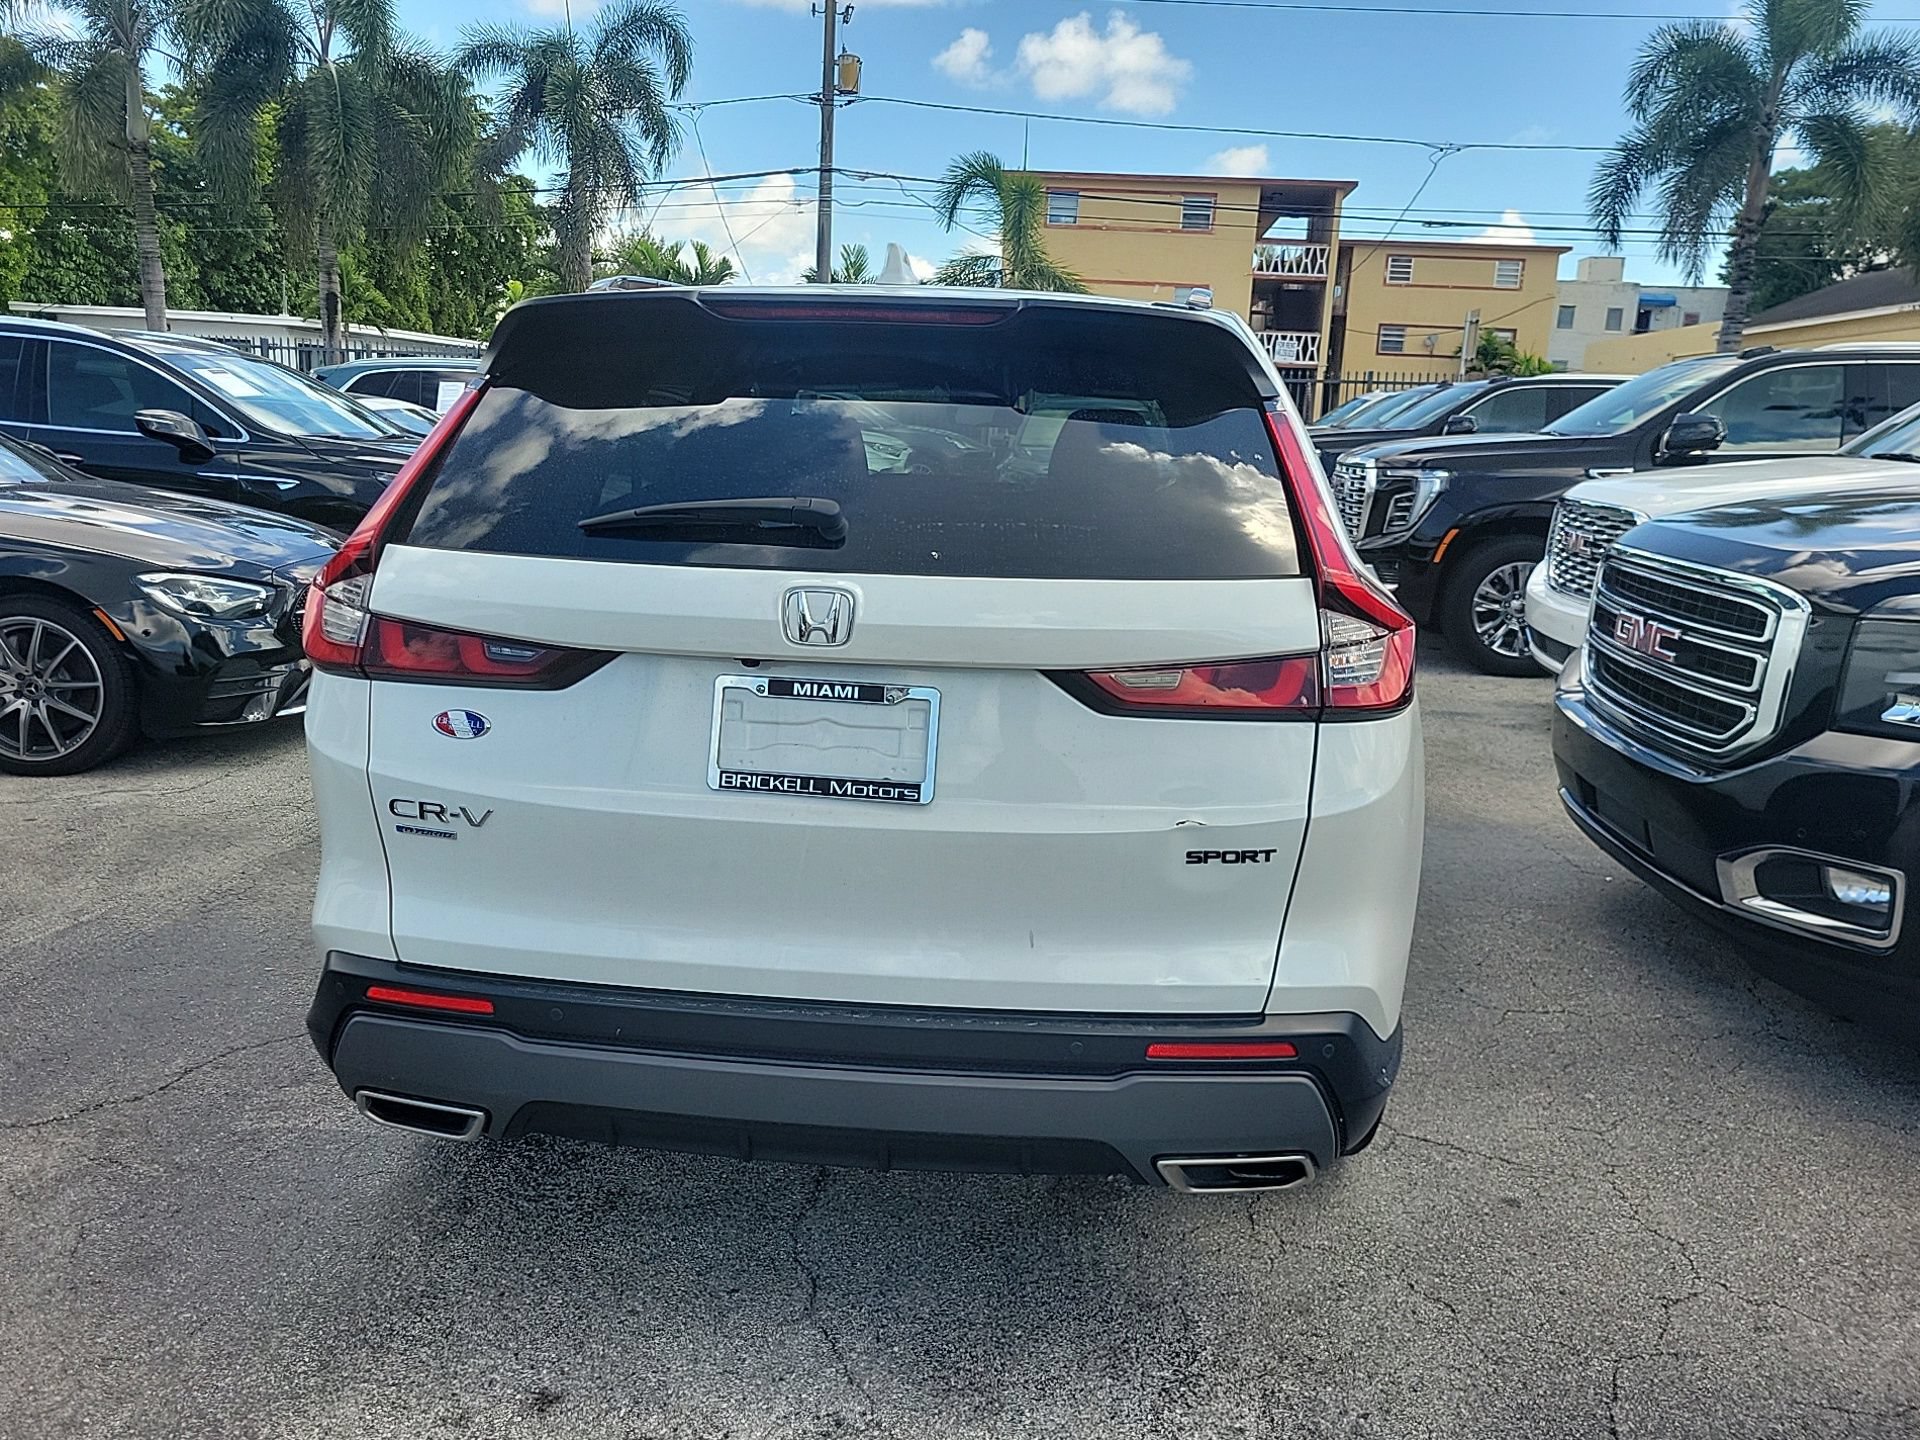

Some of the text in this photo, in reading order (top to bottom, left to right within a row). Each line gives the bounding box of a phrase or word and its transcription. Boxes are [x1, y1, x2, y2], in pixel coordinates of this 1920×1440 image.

[1614, 610, 1682, 662] GMC
[792, 682, 860, 700] MIAMI
[720, 772, 823, 794] BRICKELL
[388, 798, 495, 828] CR-V
[1185, 848, 1278, 865] SPORT
